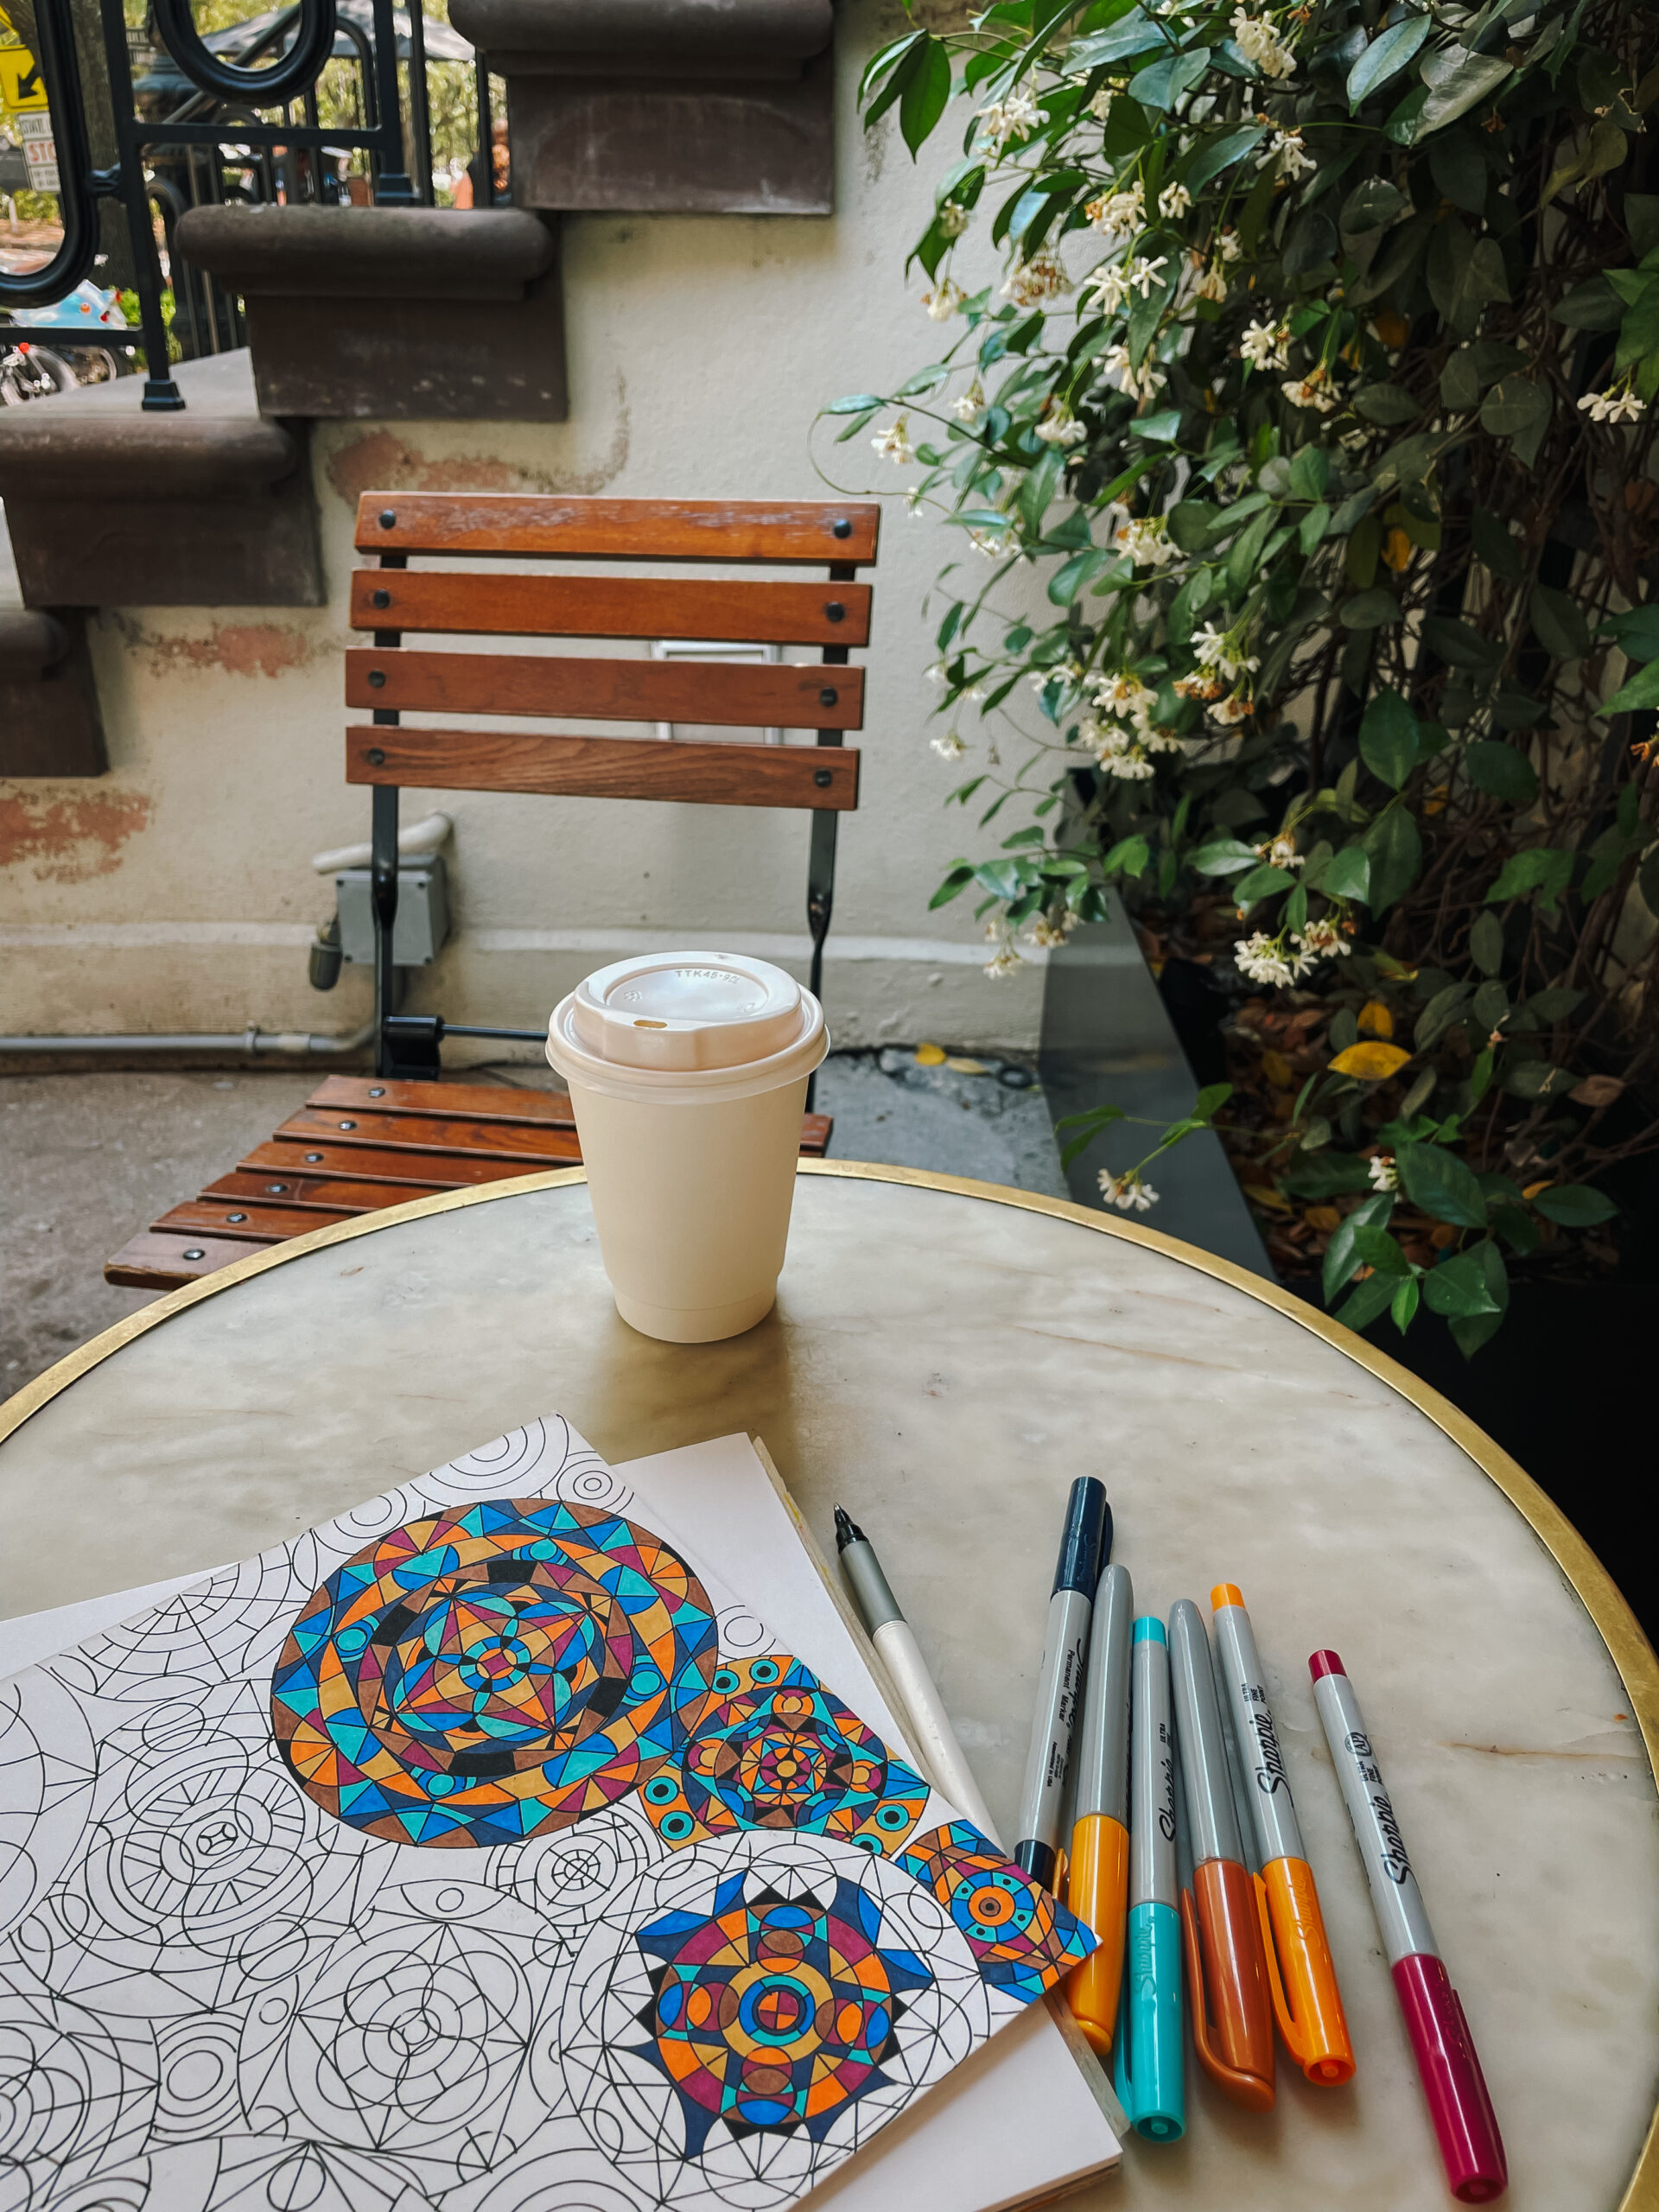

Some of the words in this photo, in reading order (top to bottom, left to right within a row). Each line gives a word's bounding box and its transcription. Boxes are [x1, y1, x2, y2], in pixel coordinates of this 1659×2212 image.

[1063, 1649, 1075, 1689] Permanent
[1250, 1688, 1260, 1701] FINE
[1058, 1694, 1069, 1722] Marker
[1366, 1767, 1377, 1783] FINE
